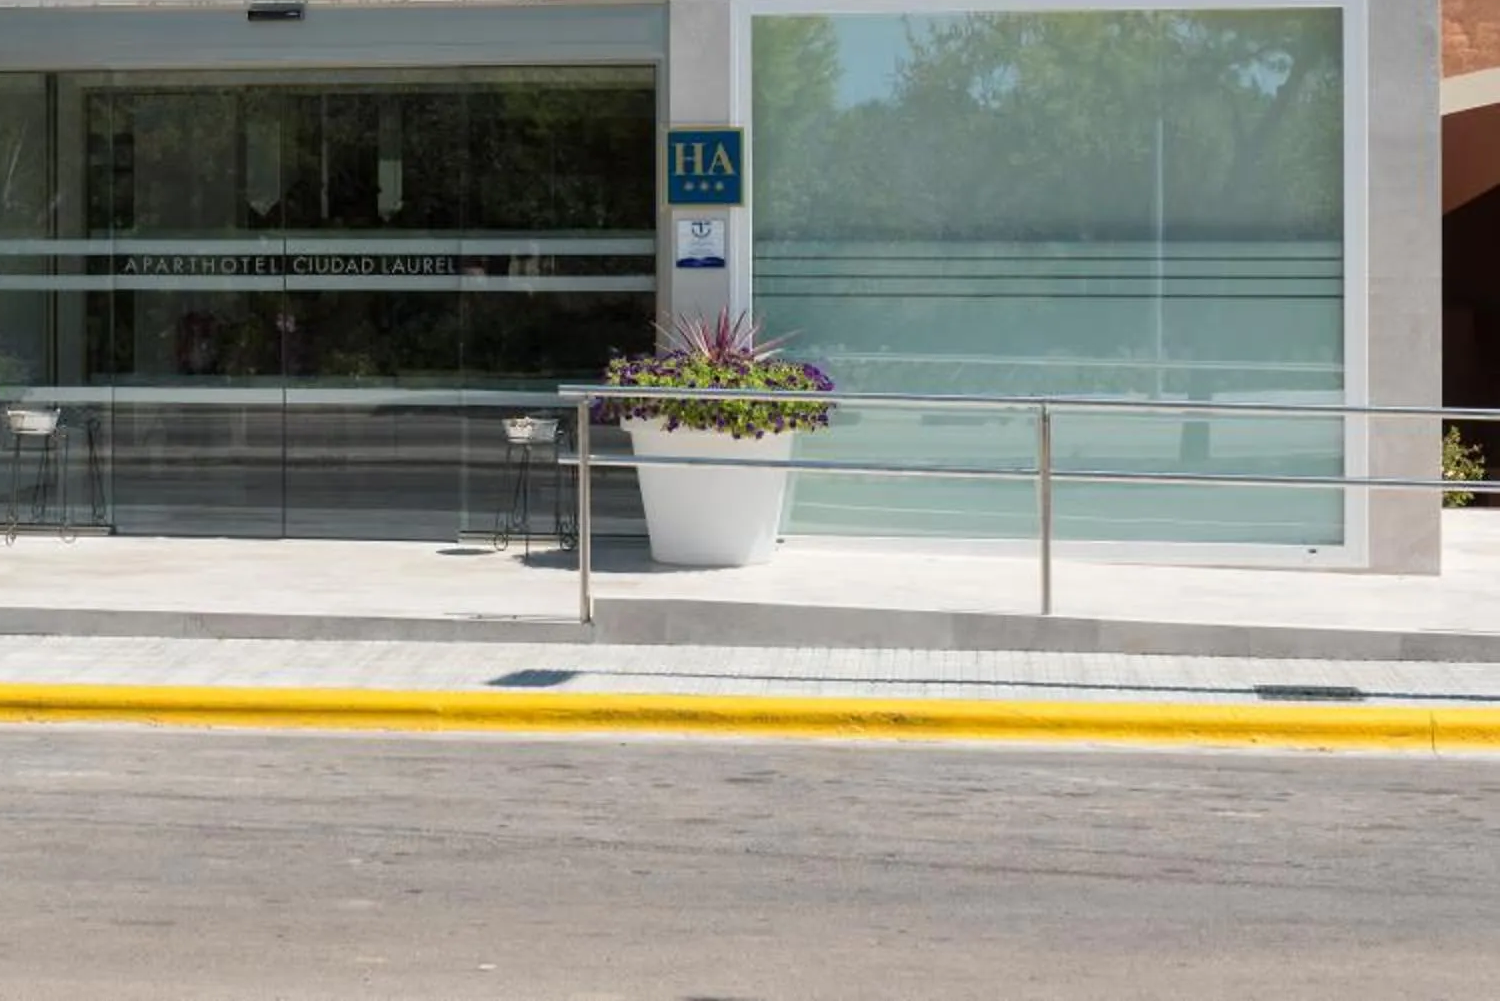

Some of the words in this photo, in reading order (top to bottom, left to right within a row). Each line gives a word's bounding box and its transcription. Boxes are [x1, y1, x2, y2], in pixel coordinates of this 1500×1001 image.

[672, 141, 737, 176] HA
[124, 256, 278, 274] APARTHOTEL
[293, 256, 374, 274] CIUDAD
[381, 256, 456, 274] LAUREL
